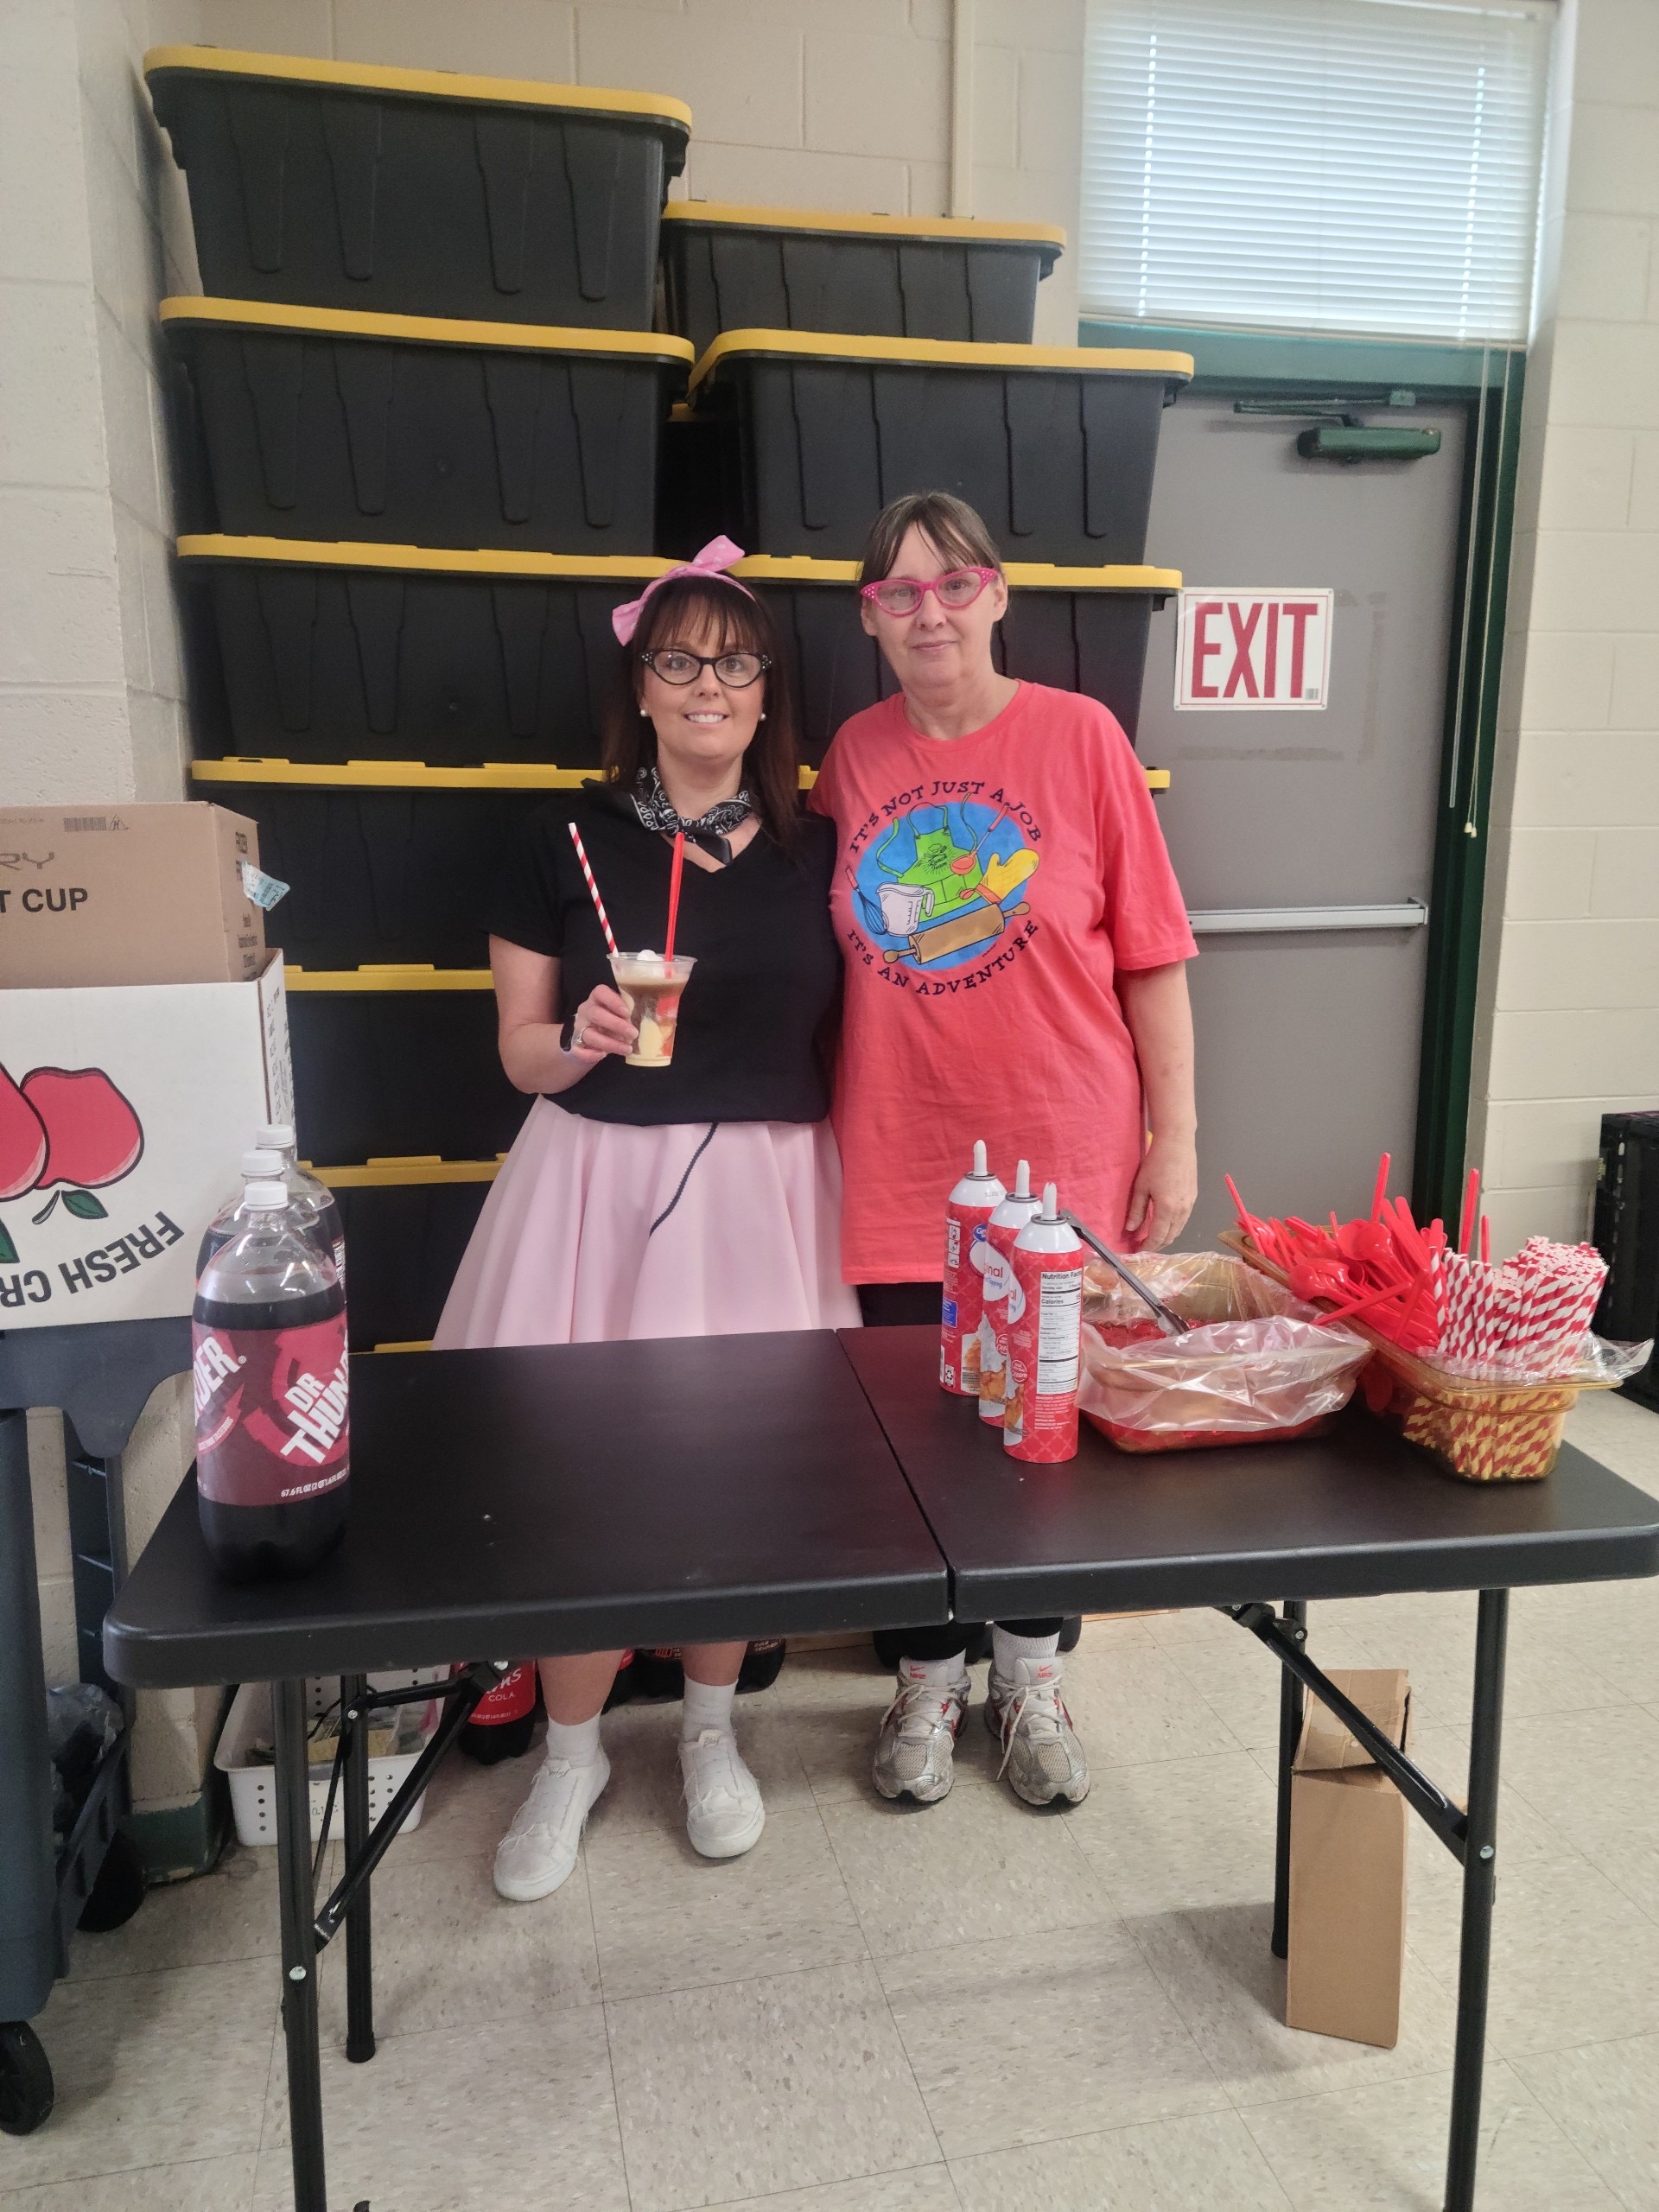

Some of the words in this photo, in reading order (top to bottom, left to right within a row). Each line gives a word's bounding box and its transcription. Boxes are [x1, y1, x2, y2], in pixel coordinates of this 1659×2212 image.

[1191, 601, 1319, 698] EXIT
[849, 811, 880, 854] IT'S
[881, 785, 925, 817] NOT
[931, 780, 985, 796] JUST
[989, 788, 1007, 804] A
[1009, 800, 1042, 842] JOB
[22, 887, 88, 913] CUP
[847, 929, 874, 965] IT'S
[878, 965, 909, 988] AN
[915, 919, 1039, 995] ADVENTURE
[58, 1211, 185, 1294] FRESH
[0, 1269, 52, 1308] CR
[283, 1372, 326, 1414] DR
[281, 1486, 296, 1497] 67.6
[296, 1485, 304, 1495] FL
[303, 1483, 312, 1493] OZ
[488, 1691, 517, 1702] COLA
